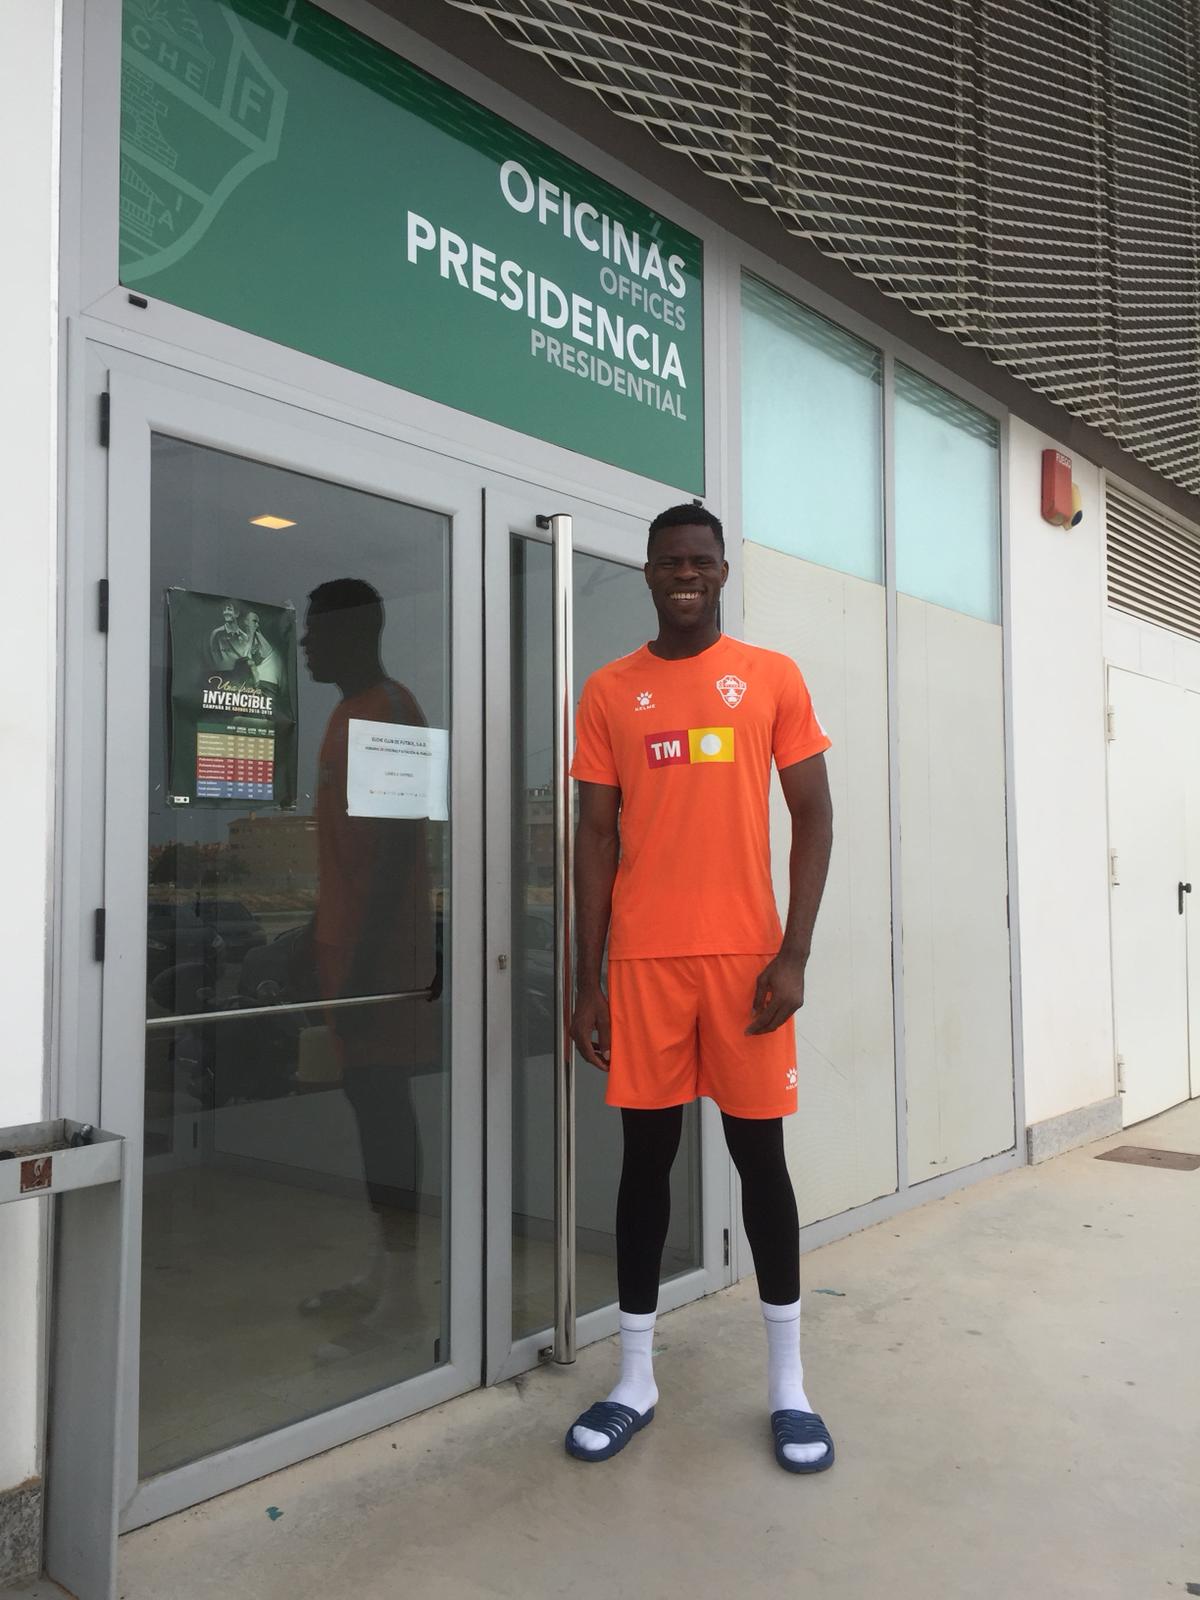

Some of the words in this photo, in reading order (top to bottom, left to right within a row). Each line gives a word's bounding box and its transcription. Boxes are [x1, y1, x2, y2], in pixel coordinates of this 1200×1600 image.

[500, 160, 687, 299] OFICINAS
[407, 210, 687, 389] PRESIDENCIA
[600, 267, 686, 331] OFFICES
[531, 329, 687, 421] PRESIDENTIAL
[203, 689, 273, 710] INVENCIBLE
[651, 740, 681, 760] TM
